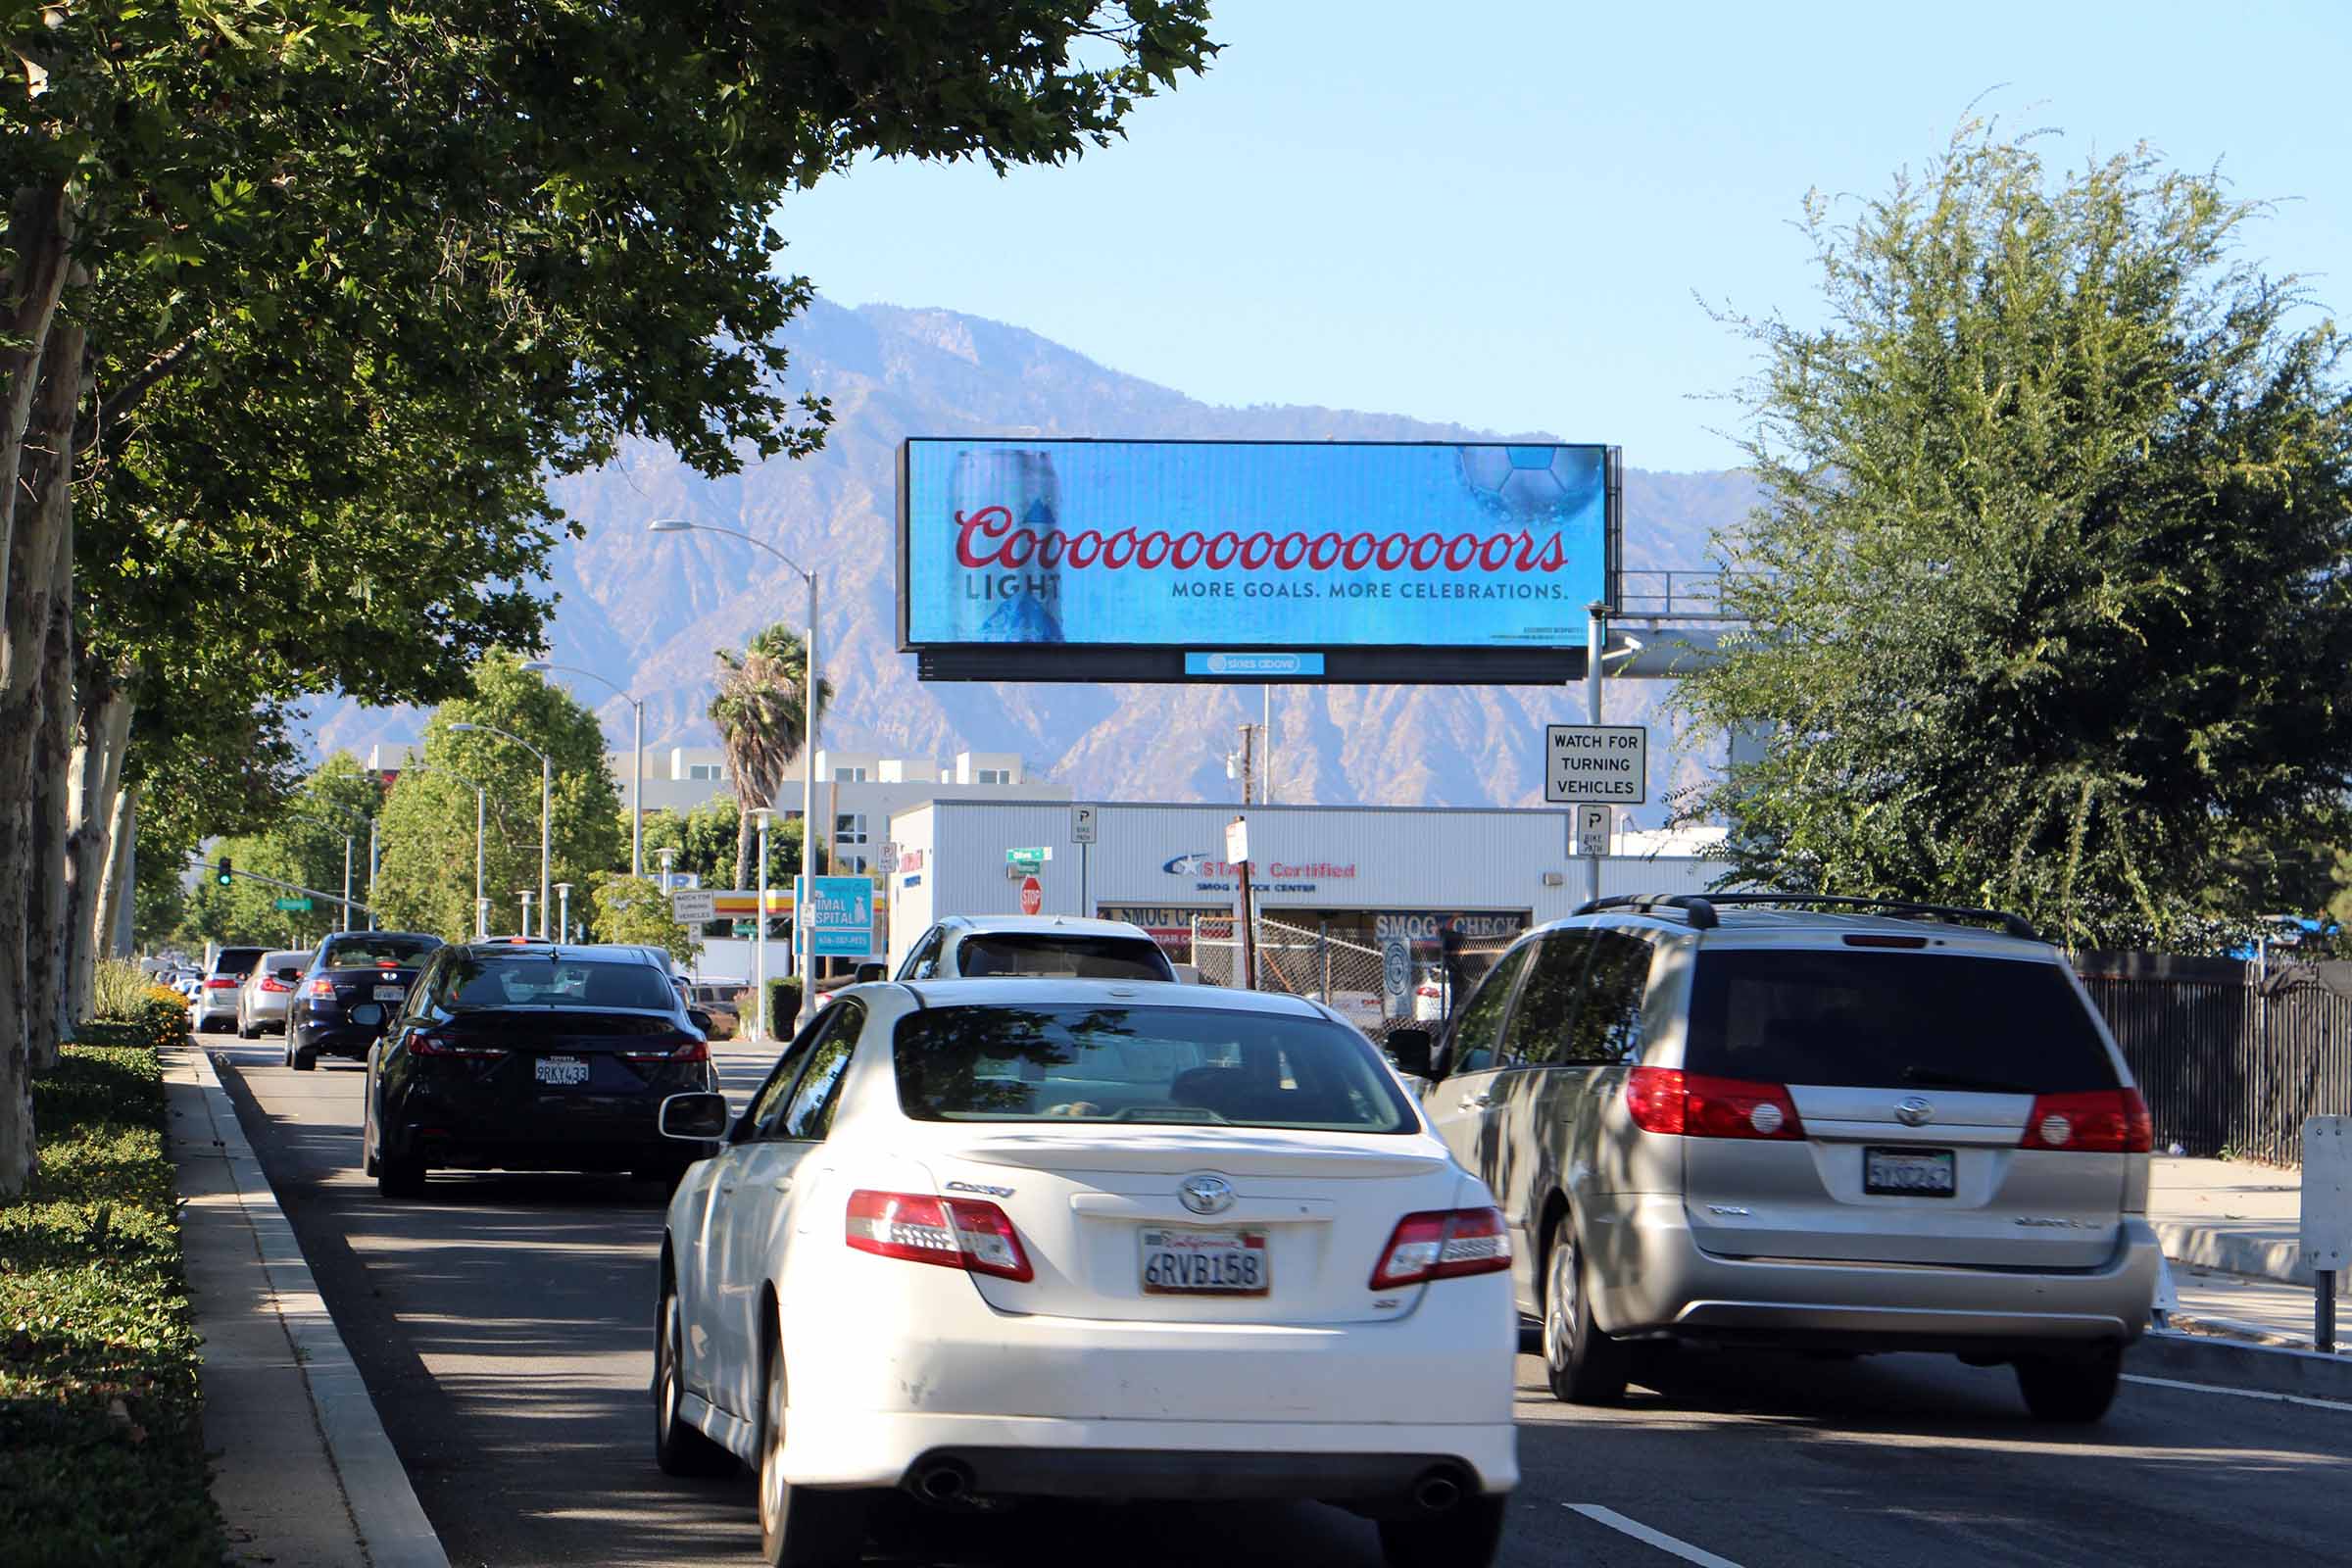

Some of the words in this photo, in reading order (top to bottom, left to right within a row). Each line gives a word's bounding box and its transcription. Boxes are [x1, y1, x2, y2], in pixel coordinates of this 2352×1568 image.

[966, 574, 1060, 600] LIGHT
[1172, 582, 1235, 597] MORE
[1244, 582, 1320, 599] GOALS.
[1329, 582, 1392, 599] MORE
[1400, 582, 1568, 601] CELEBRATIONS.
[1554, 735, 1601, 748] WATCH
[1609, 736, 1638, 749] FOR
[1561, 758, 1630, 771] TURNING
[1558, 780, 1634, 794] VEHICLES
[1270, 861, 1356, 879] Certified
[1274, 884, 1316, 893] CENTER
[1022, 889, 1041, 905] STOP
[815, 900, 846, 910] IMAL
[815, 912, 855, 924] SPITAL
[1121, 908, 1169, 926] SMOG
[1376, 915, 1437, 938] SMOG
[1452, 916, 1519, 936] CHECK
[537, 1066, 587, 1081] 9RKY433
[1145, 1252, 1258, 1285] 6RVB158
